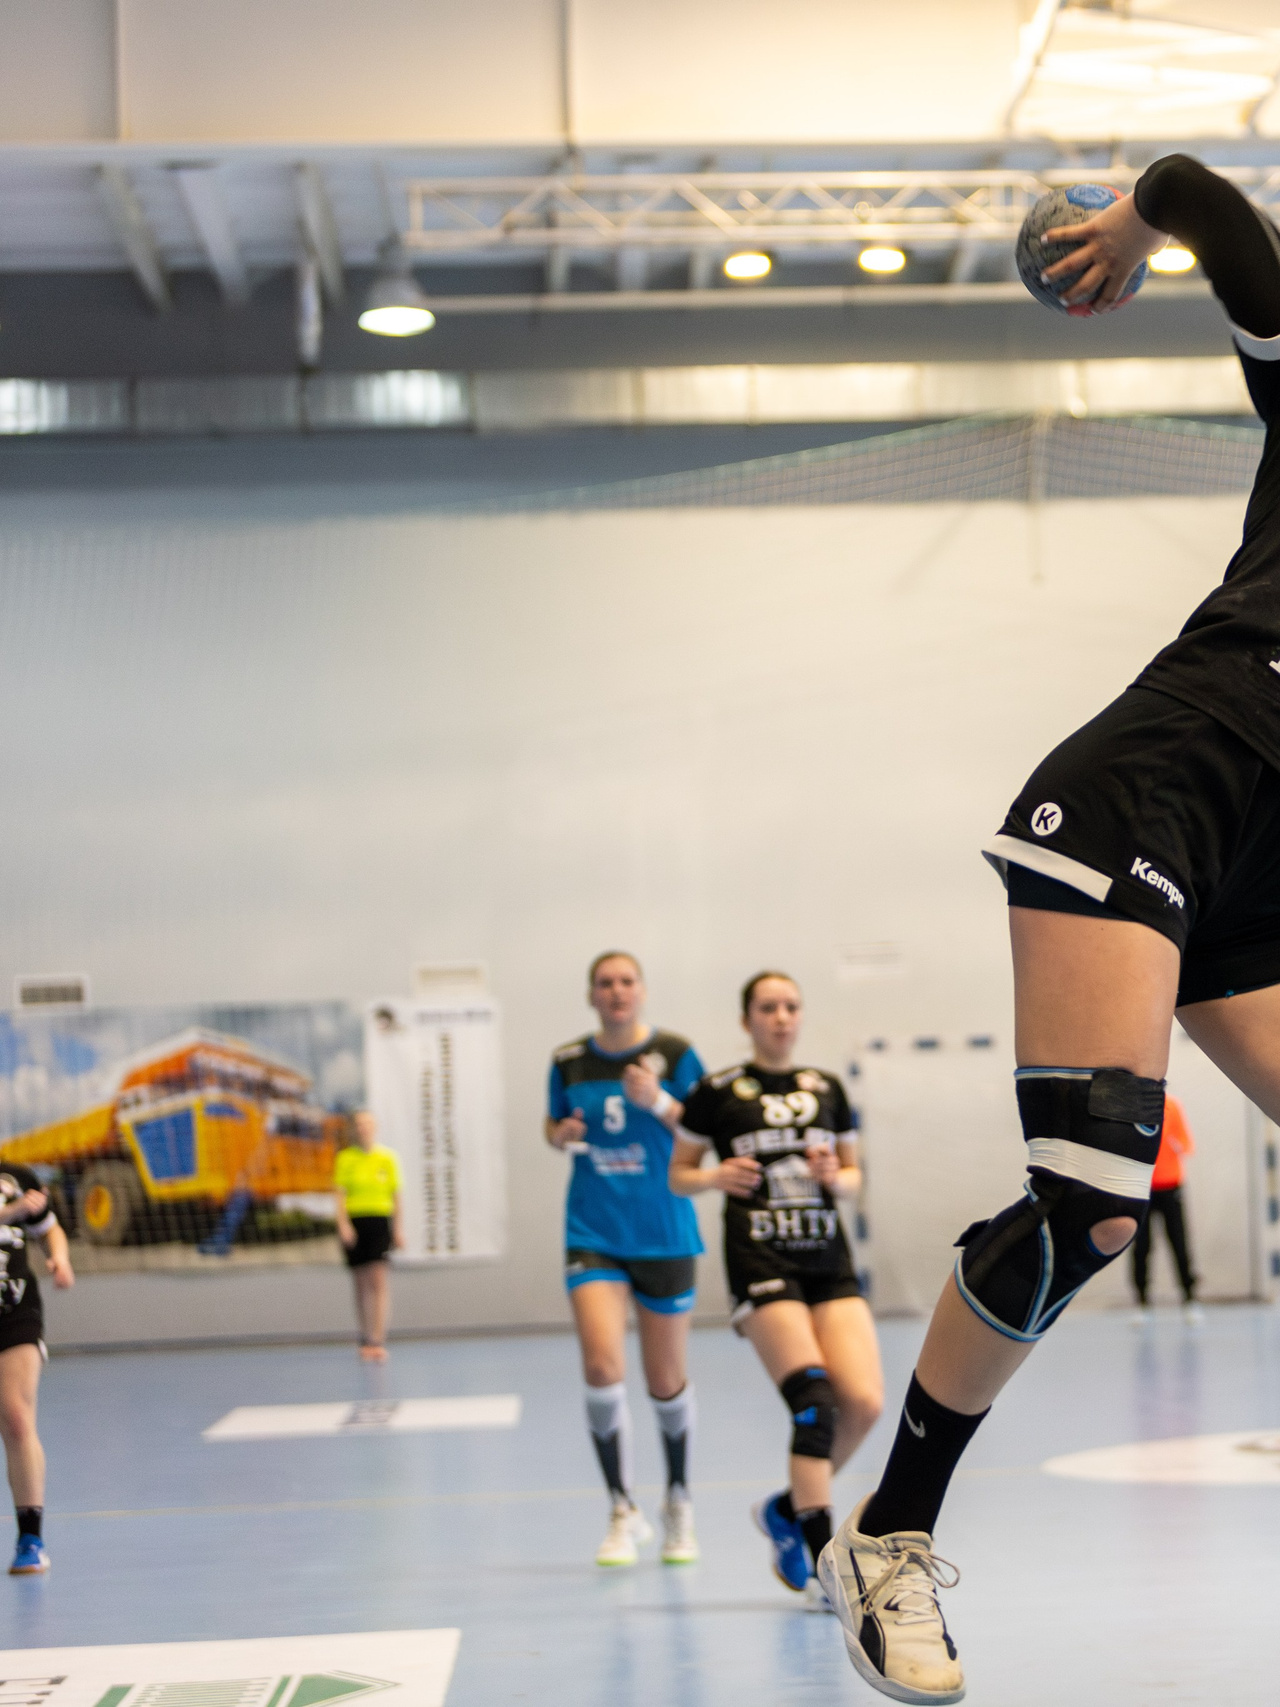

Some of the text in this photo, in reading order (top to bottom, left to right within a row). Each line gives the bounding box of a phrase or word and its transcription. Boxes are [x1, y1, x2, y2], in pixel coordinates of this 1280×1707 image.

[1130, 857, 1185, 909] Kempa
[603, 1095, 627, 1134] 5
[731, 1128, 837, 1158] BEL
[748, 1209, 838, 1241] БНТУ
